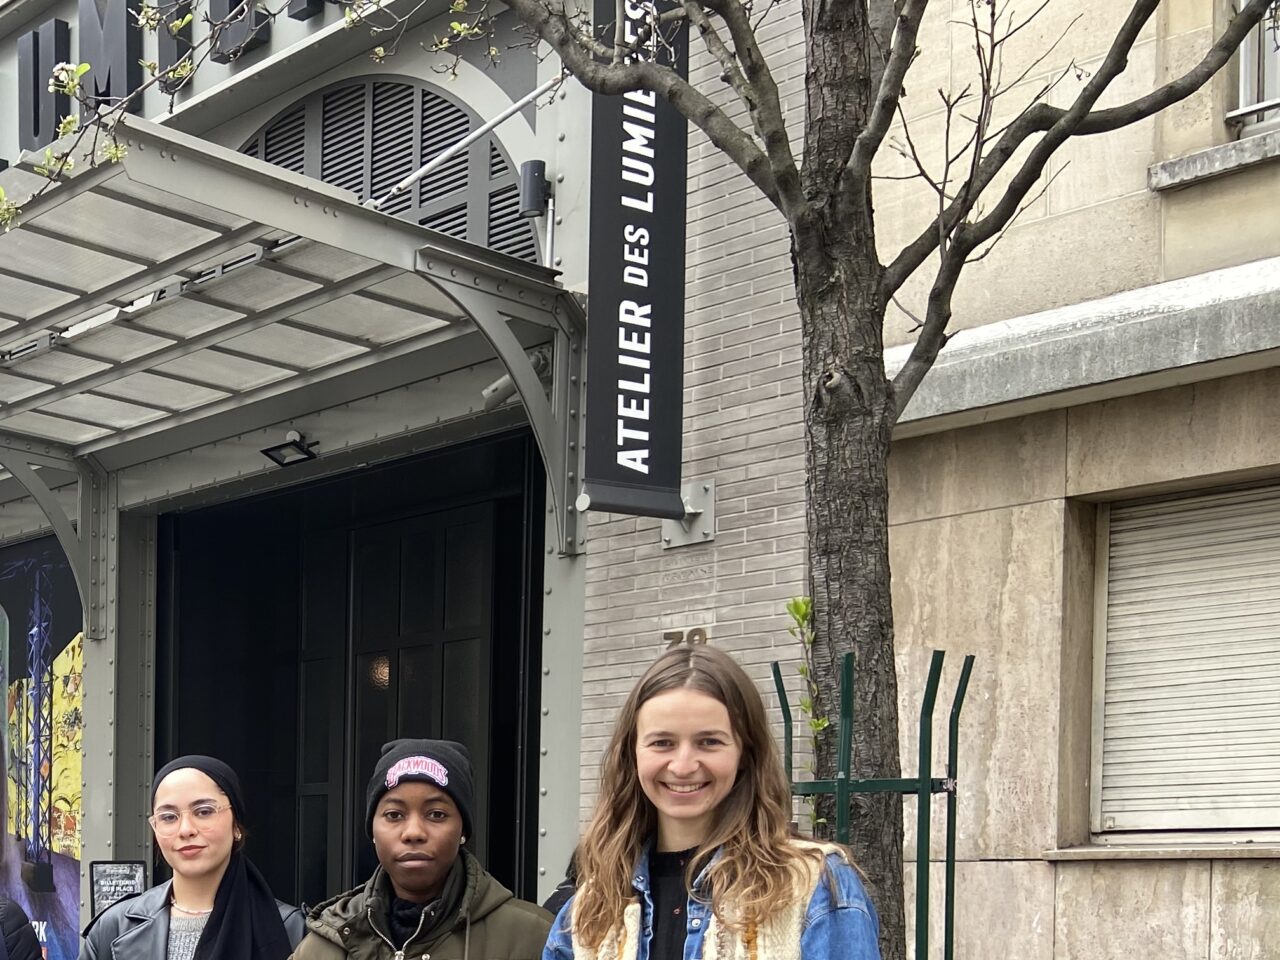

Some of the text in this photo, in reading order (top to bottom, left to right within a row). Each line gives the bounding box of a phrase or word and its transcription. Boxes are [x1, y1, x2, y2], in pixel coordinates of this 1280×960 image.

[617, 0, 656, 475] ATELIER DES LUMIEES
